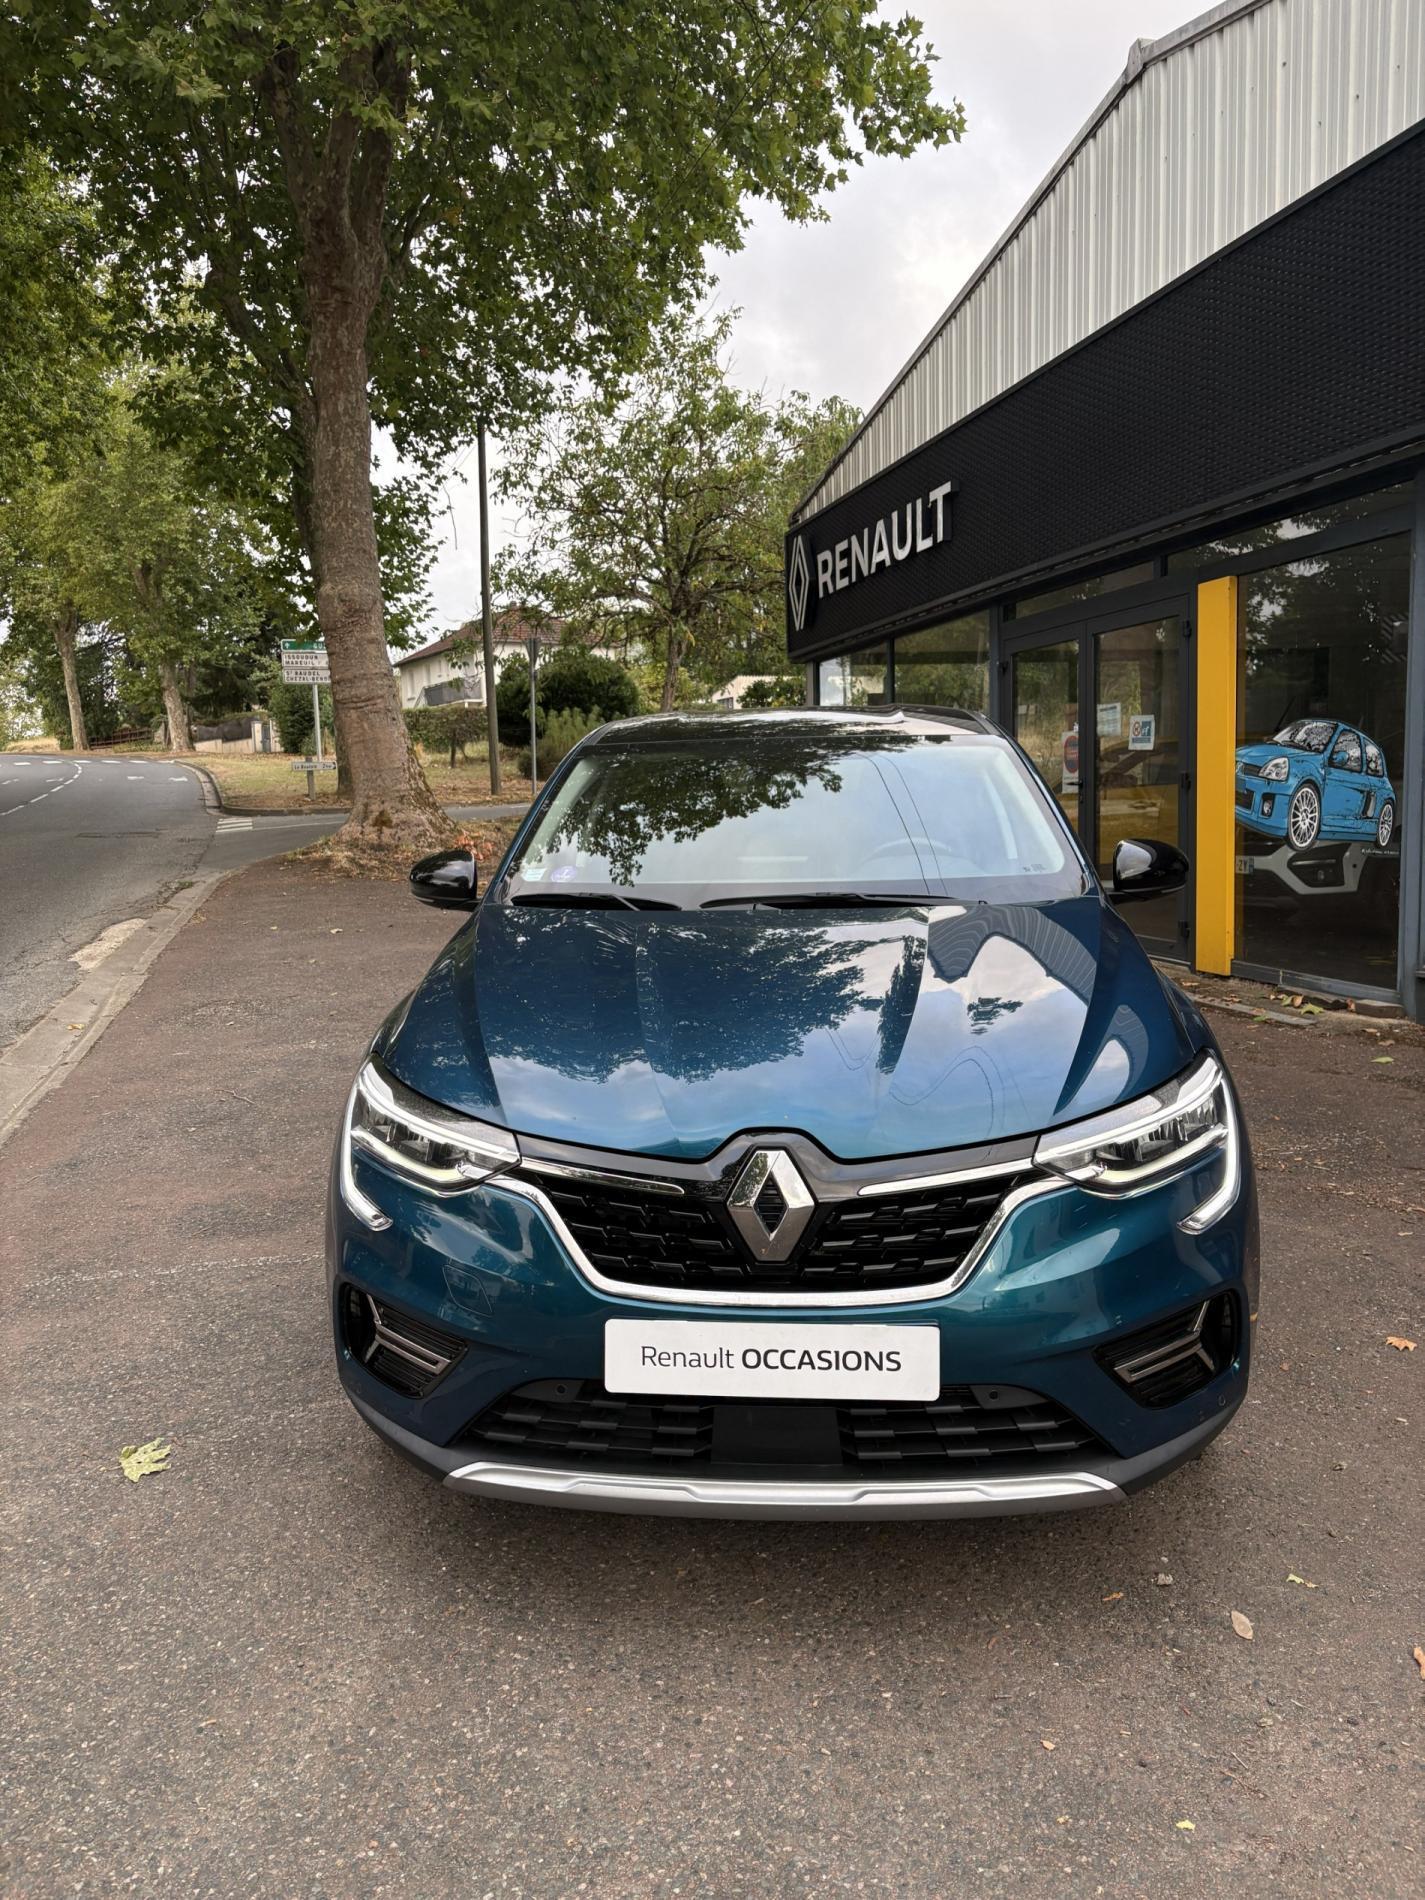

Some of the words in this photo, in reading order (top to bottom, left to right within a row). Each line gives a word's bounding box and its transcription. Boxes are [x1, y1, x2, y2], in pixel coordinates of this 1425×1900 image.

[816, 481, 952, 599] RENAULT
[641, 1345, 735, 1369] Renault
[741, 1348, 902, 1372] OCCASIONS
